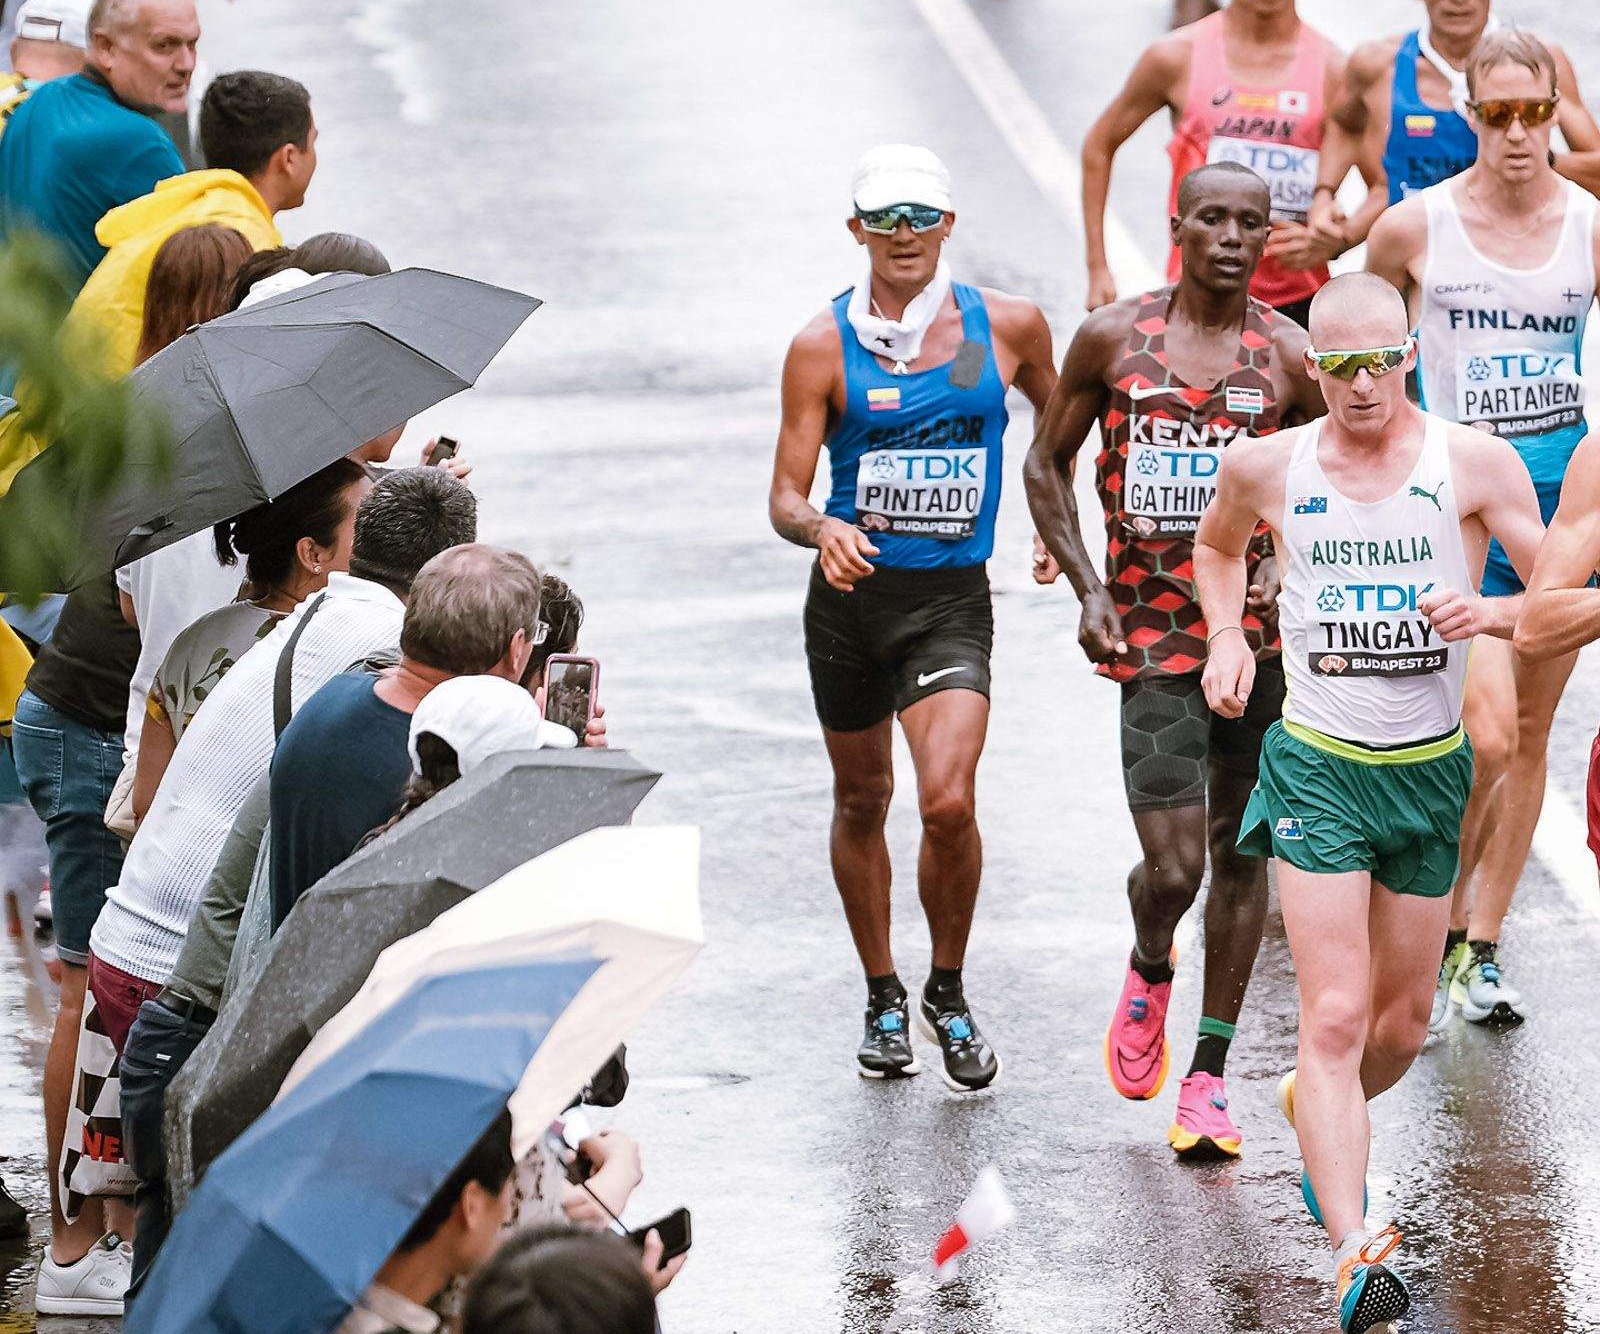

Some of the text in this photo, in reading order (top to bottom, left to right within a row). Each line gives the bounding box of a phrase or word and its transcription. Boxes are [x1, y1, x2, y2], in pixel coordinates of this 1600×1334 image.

[1215, 118, 1296, 138] JAPAN
[1244, 148, 1311, 173] TDK
[1450, 309, 1577, 334] FINLAND
[1491, 355, 1567, 378] TDK
[1465, 383, 1580, 415] PARTANEN
[1497, 410, 1577, 435] BUDAPEST 23
[897, 454, 978, 479] TDK
[865, 485, 979, 513] PINTADO
[892, 520, 963, 535] BUDAPEST
[1312, 536, 1433, 566] AUSTRALIA
[1345, 582, 1436, 612] TDK
[1319, 620, 1433, 650] TINGAY
[1351, 655, 1442, 671] BUDAPEST 23
